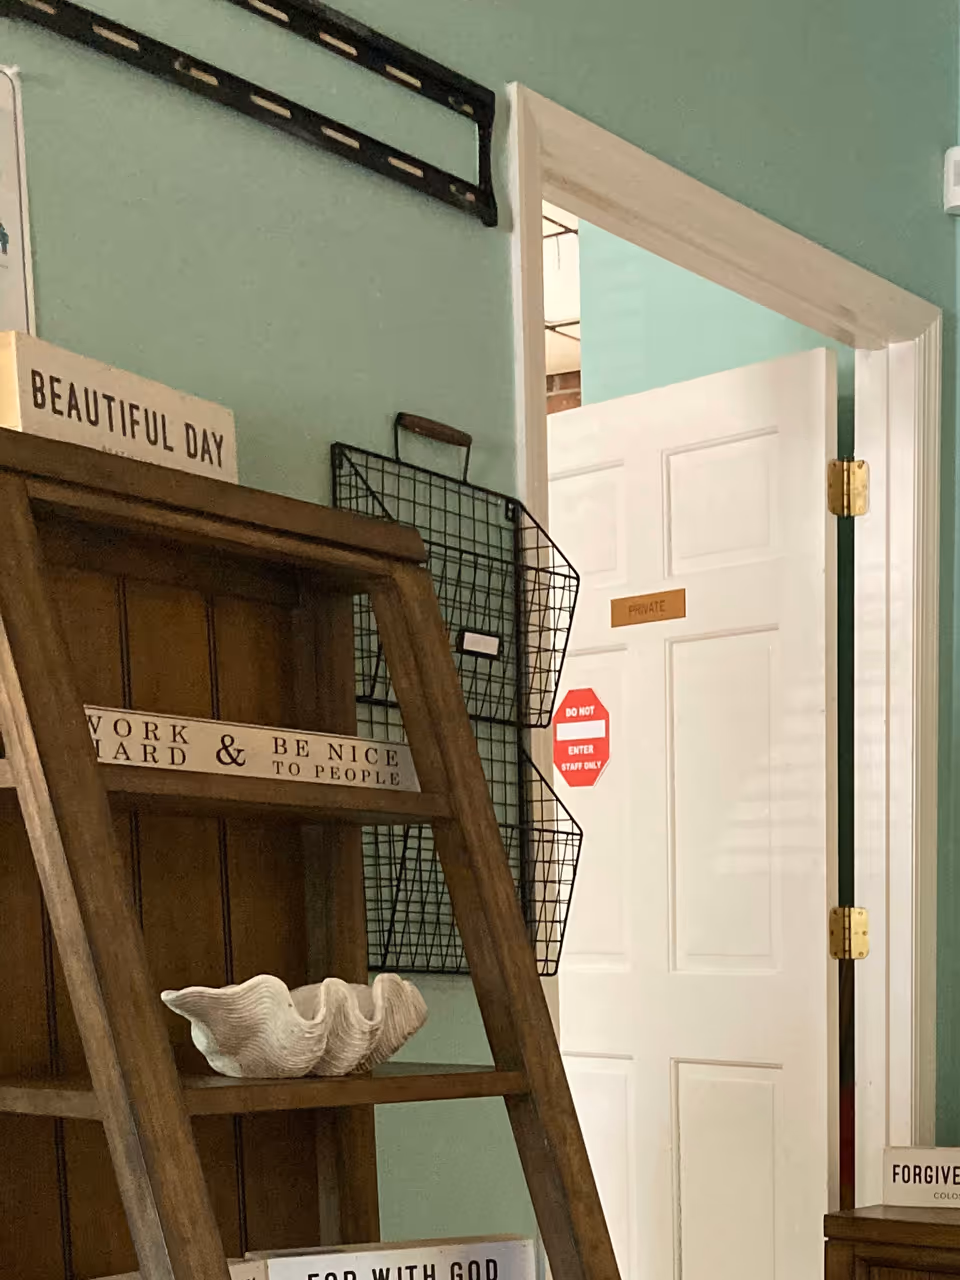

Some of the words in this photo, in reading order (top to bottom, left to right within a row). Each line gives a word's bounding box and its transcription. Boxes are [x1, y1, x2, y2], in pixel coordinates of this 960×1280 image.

[31, 369, 174, 452] BEAUTIFUL
[184, 421, 223, 468] DAY
[628, 600, 666, 616] PRIVATE
[565, 707, 577, 717] DO
[579, 706, 595, 716] NOT
[215, 734, 246, 767] &
[272, 736, 309, 758] BE
[327, 743, 399, 767] NICE
[568, 745, 594, 755] ENTER
[273, 760, 301, 776] TO
[314, 764, 401, 786] PEOPLE
[561, 762, 582, 772] STAFF
[584, 761, 602, 771] ONLY
[892, 1164, 960, 1185] FORGIVE
